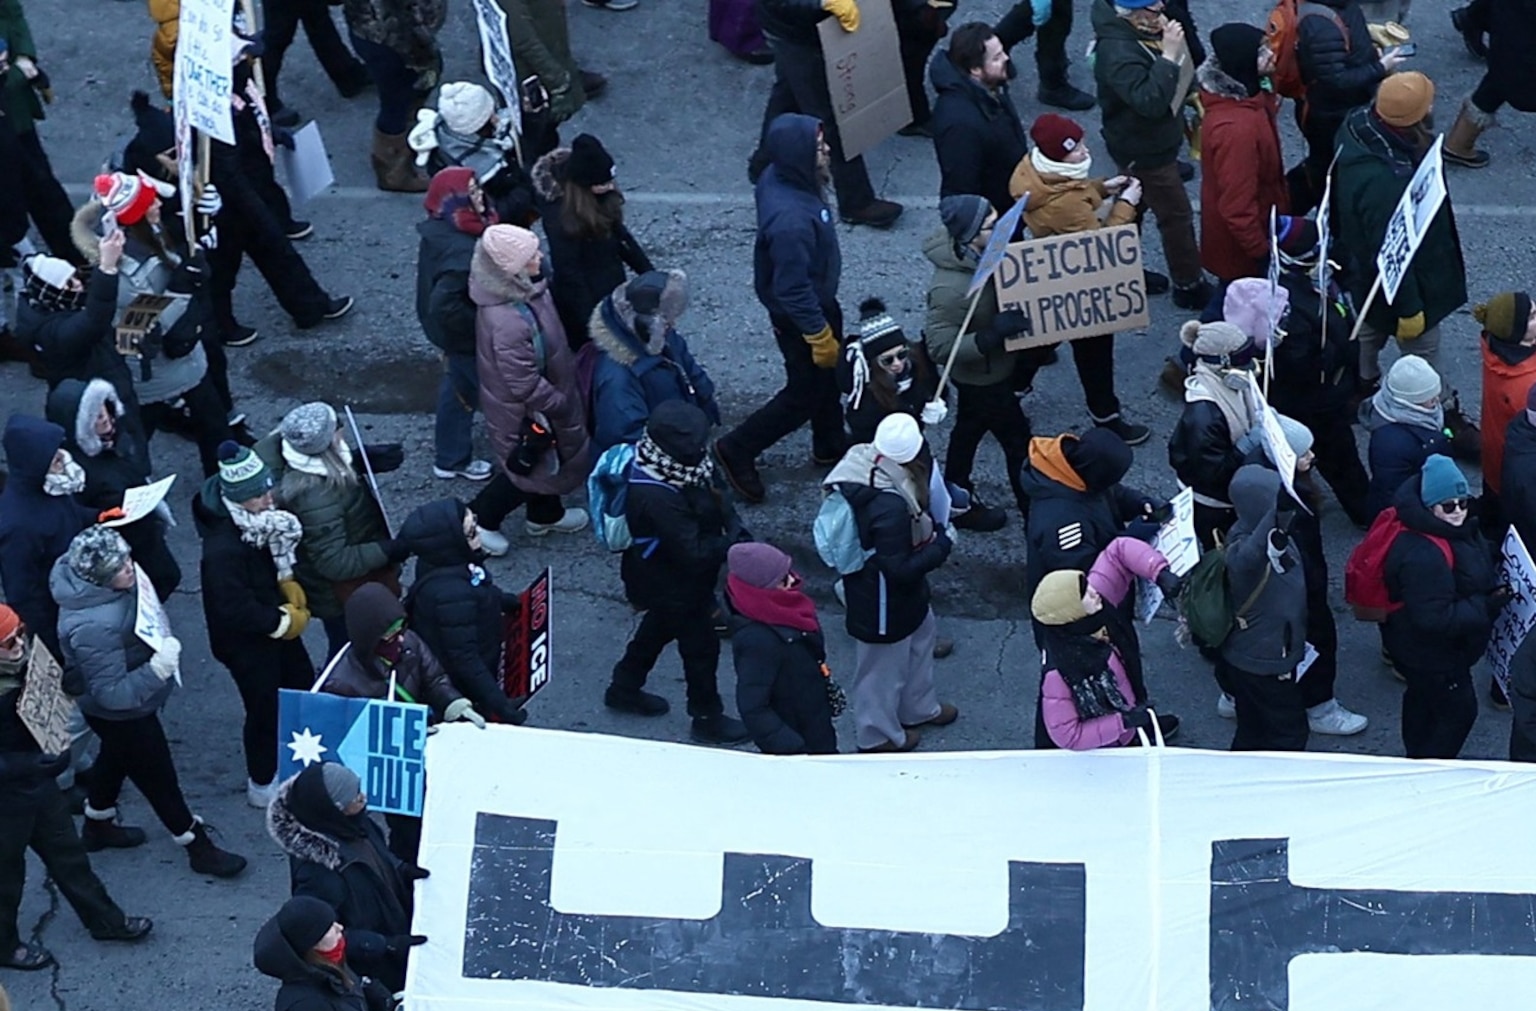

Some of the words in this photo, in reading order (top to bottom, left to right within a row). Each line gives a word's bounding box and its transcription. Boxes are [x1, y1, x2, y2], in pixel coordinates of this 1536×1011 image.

[1001, 230, 1138, 290] DE-ICING
[1038, 279, 1145, 334] PROGRESS
[531, 577, 548, 631] NO
[530, 632, 548, 692] ICE
[368, 704, 424, 760] ICE
[366, 755, 422, 813] OUT
